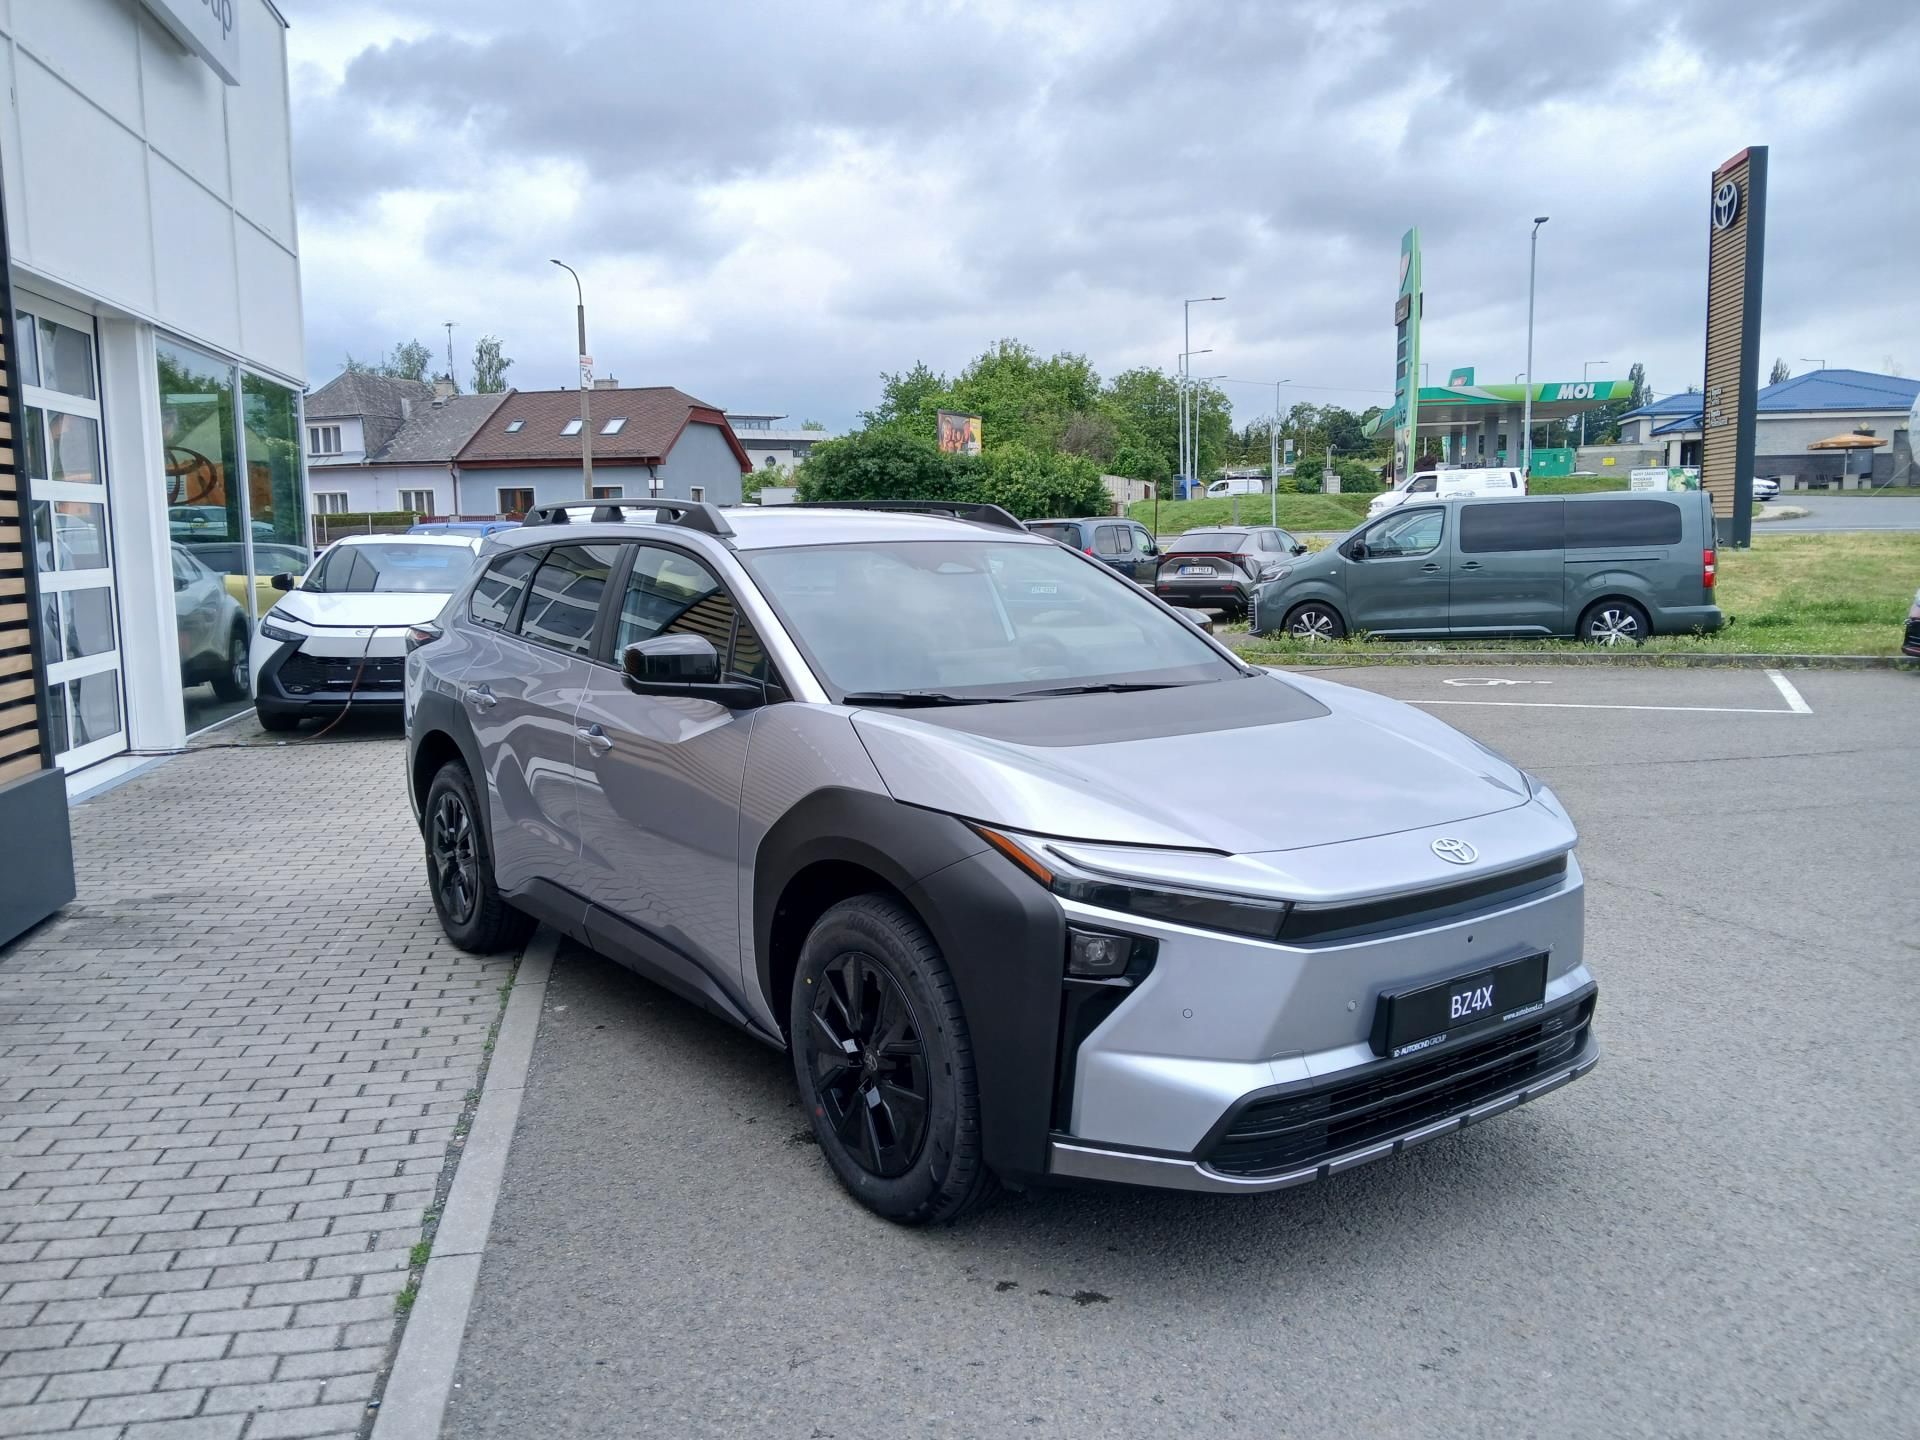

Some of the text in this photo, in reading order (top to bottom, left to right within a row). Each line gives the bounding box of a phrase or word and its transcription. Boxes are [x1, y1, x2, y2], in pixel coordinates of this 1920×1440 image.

[1557, 383, 1596, 399] MOL
[1451, 984, 1493, 1019] BZ4X
[1401, 1039, 1430, 1055] AUTOBOND
